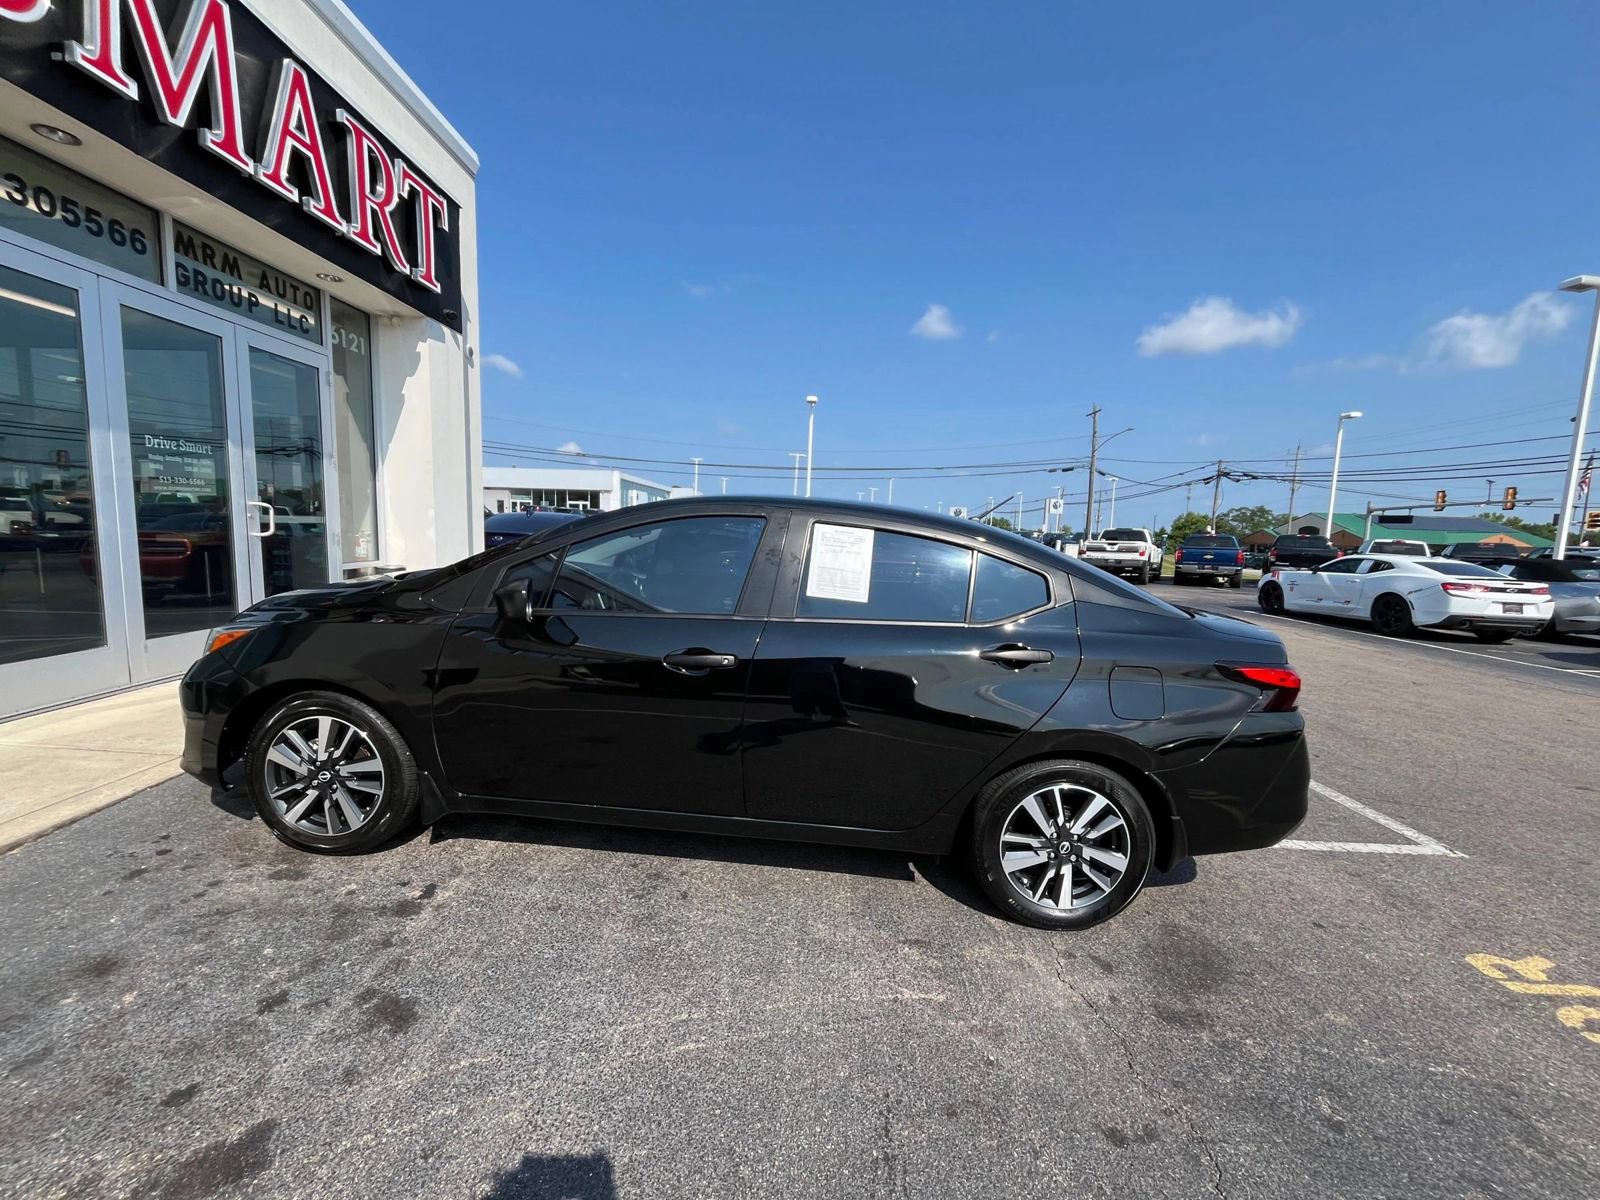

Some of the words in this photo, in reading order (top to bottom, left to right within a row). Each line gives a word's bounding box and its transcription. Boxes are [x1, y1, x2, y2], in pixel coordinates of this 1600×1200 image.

[0, 0, 448, 294] MART
[4, 172, 147, 256] 305566
[175, 230, 243, 281] MRM
[258, 270, 314, 311] AUTO
[175, 261, 260, 313] GROUP
[274, 302, 310, 334] LLC
[331, 325, 365, 355] 6121
[144, 434, 177, 450] Drive
[179, 439, 213, 455] Smart
